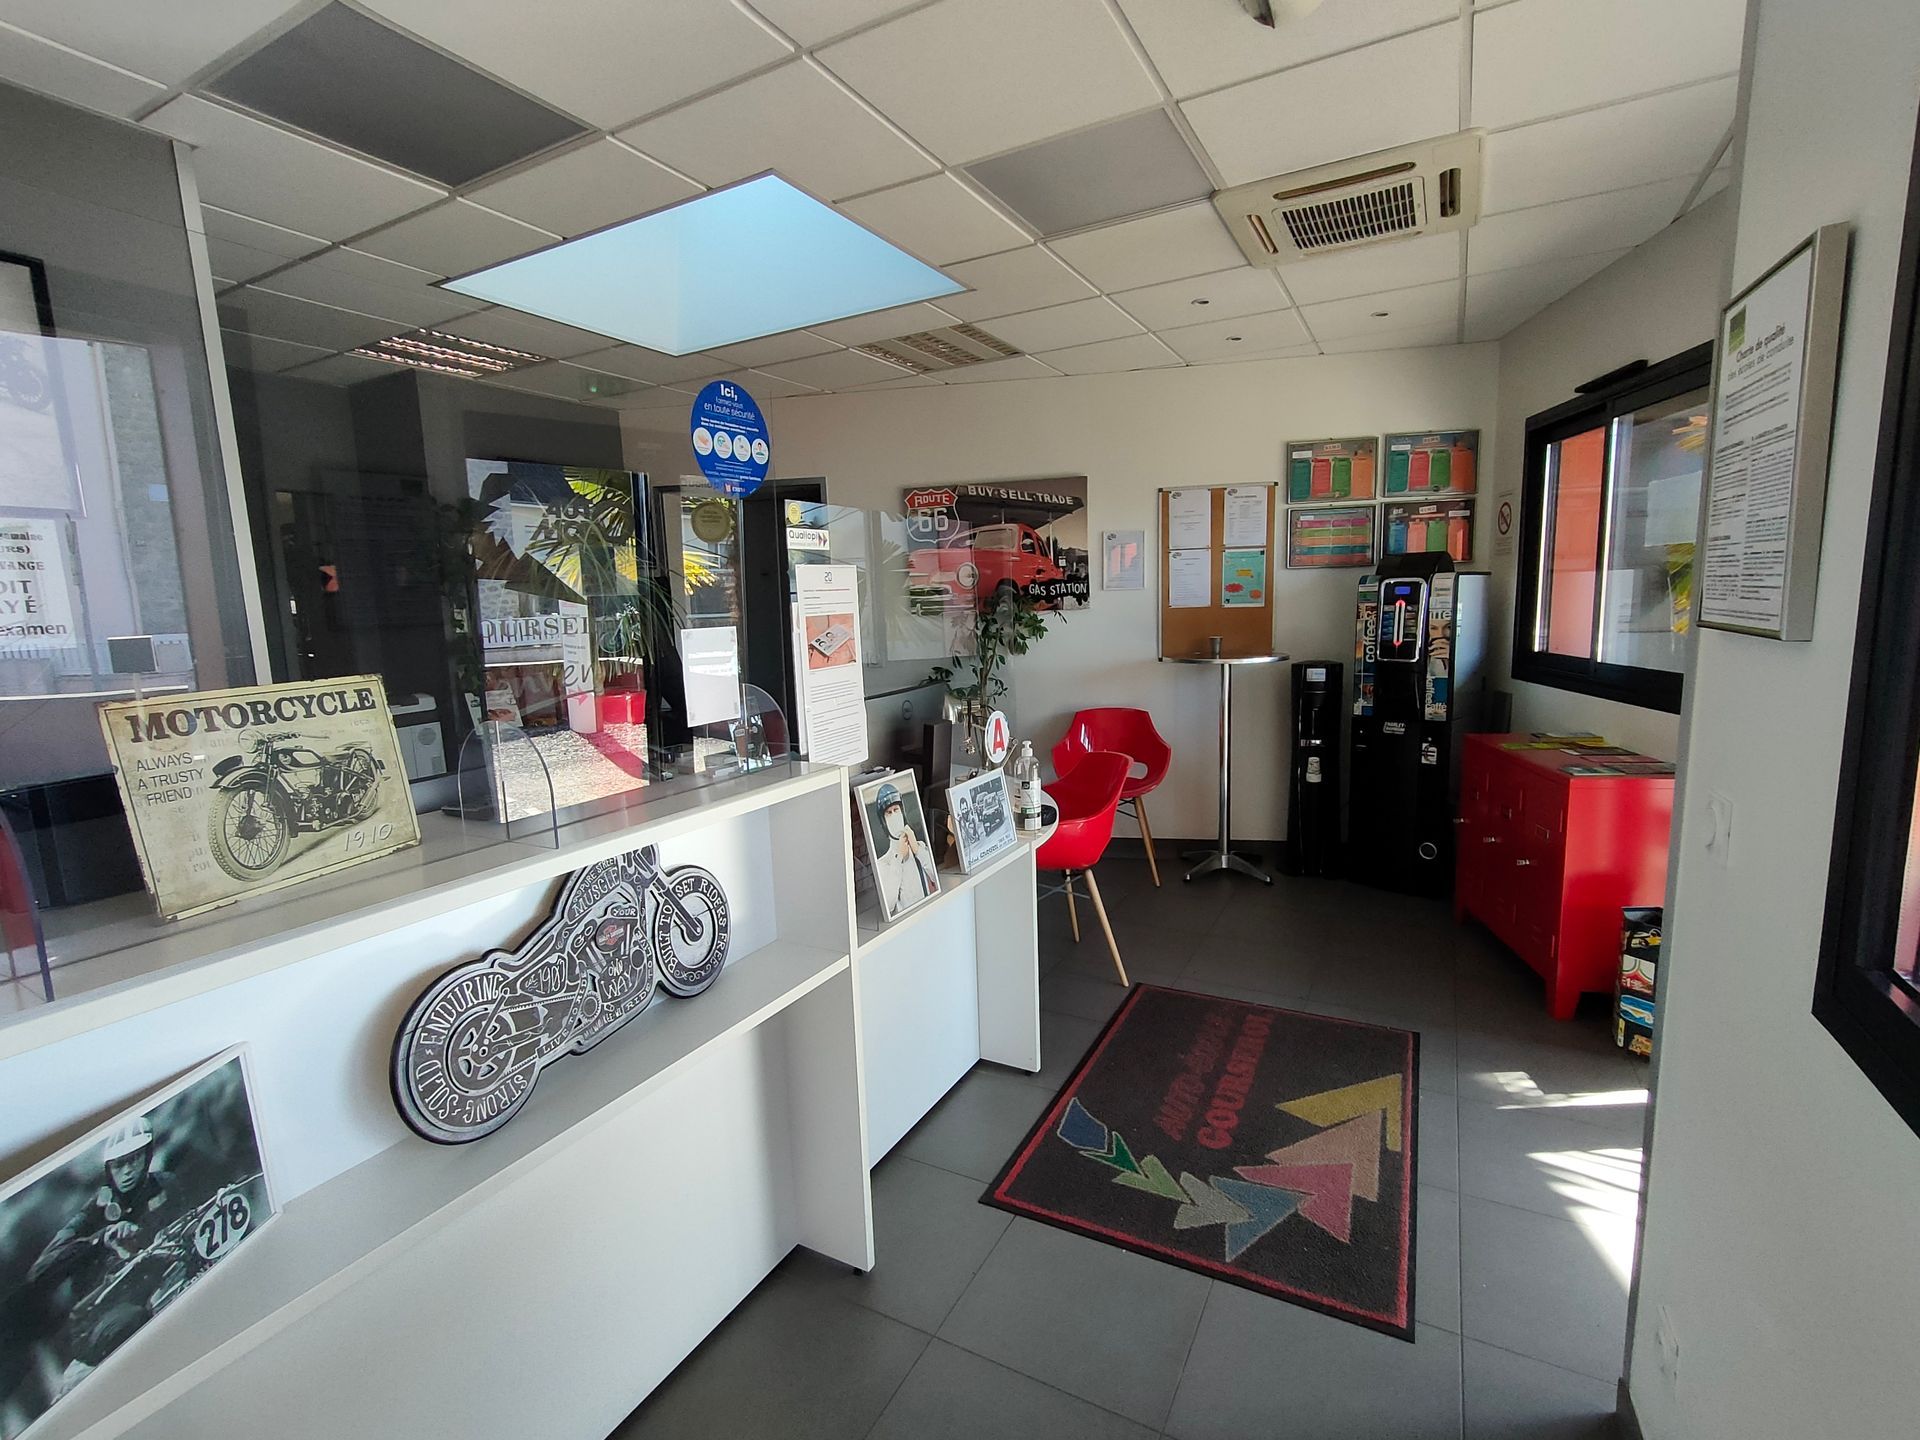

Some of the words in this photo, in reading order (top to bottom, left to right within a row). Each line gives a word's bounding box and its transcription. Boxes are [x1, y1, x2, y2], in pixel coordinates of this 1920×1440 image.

[720, 383, 738, 401] Ici,
[704, 402, 713, 411] en
[914, 493, 950, 507] ROUTE
[1036, 492, 1074, 505] TRADE
[917, 507, 949, 533] 66
[1028, 582, 1046, 595] GAS
[1049, 581, 1087, 595] STATION
[0, 595, 38, 614] YÉ
[125, 687, 377, 743] MOTORCYCLE
[992, 717, 1006, 755] A
[136, 751, 193, 773] ALWAYS
[137, 778, 149, 792] A
[151, 768, 205, 788] TRUSTY
[146, 786, 192, 807] FRIEND
[344, 822, 393, 851] 1910
[571, 866, 620, 918] MUSCLE
[580, 870, 598, 893] PURE
[675, 878, 695, 898] SET
[612, 907, 637, 917] YOUR
[659, 903, 674, 926] TO
[698, 878, 727, 928] RIDERS
[573, 924, 594, 949] GO
[658, 930, 679, 974] BUILT
[709, 932, 729, 969] FREE
[600, 965, 633, 999] WAY
[419, 973, 505, 1045] ENDURING
[625, 982, 651, 1012] RIDE
[542, 1029, 569, 1053] LIVE
[415, 1059, 460, 1120] SOLID
[462, 1074, 529, 1124] STRONG
